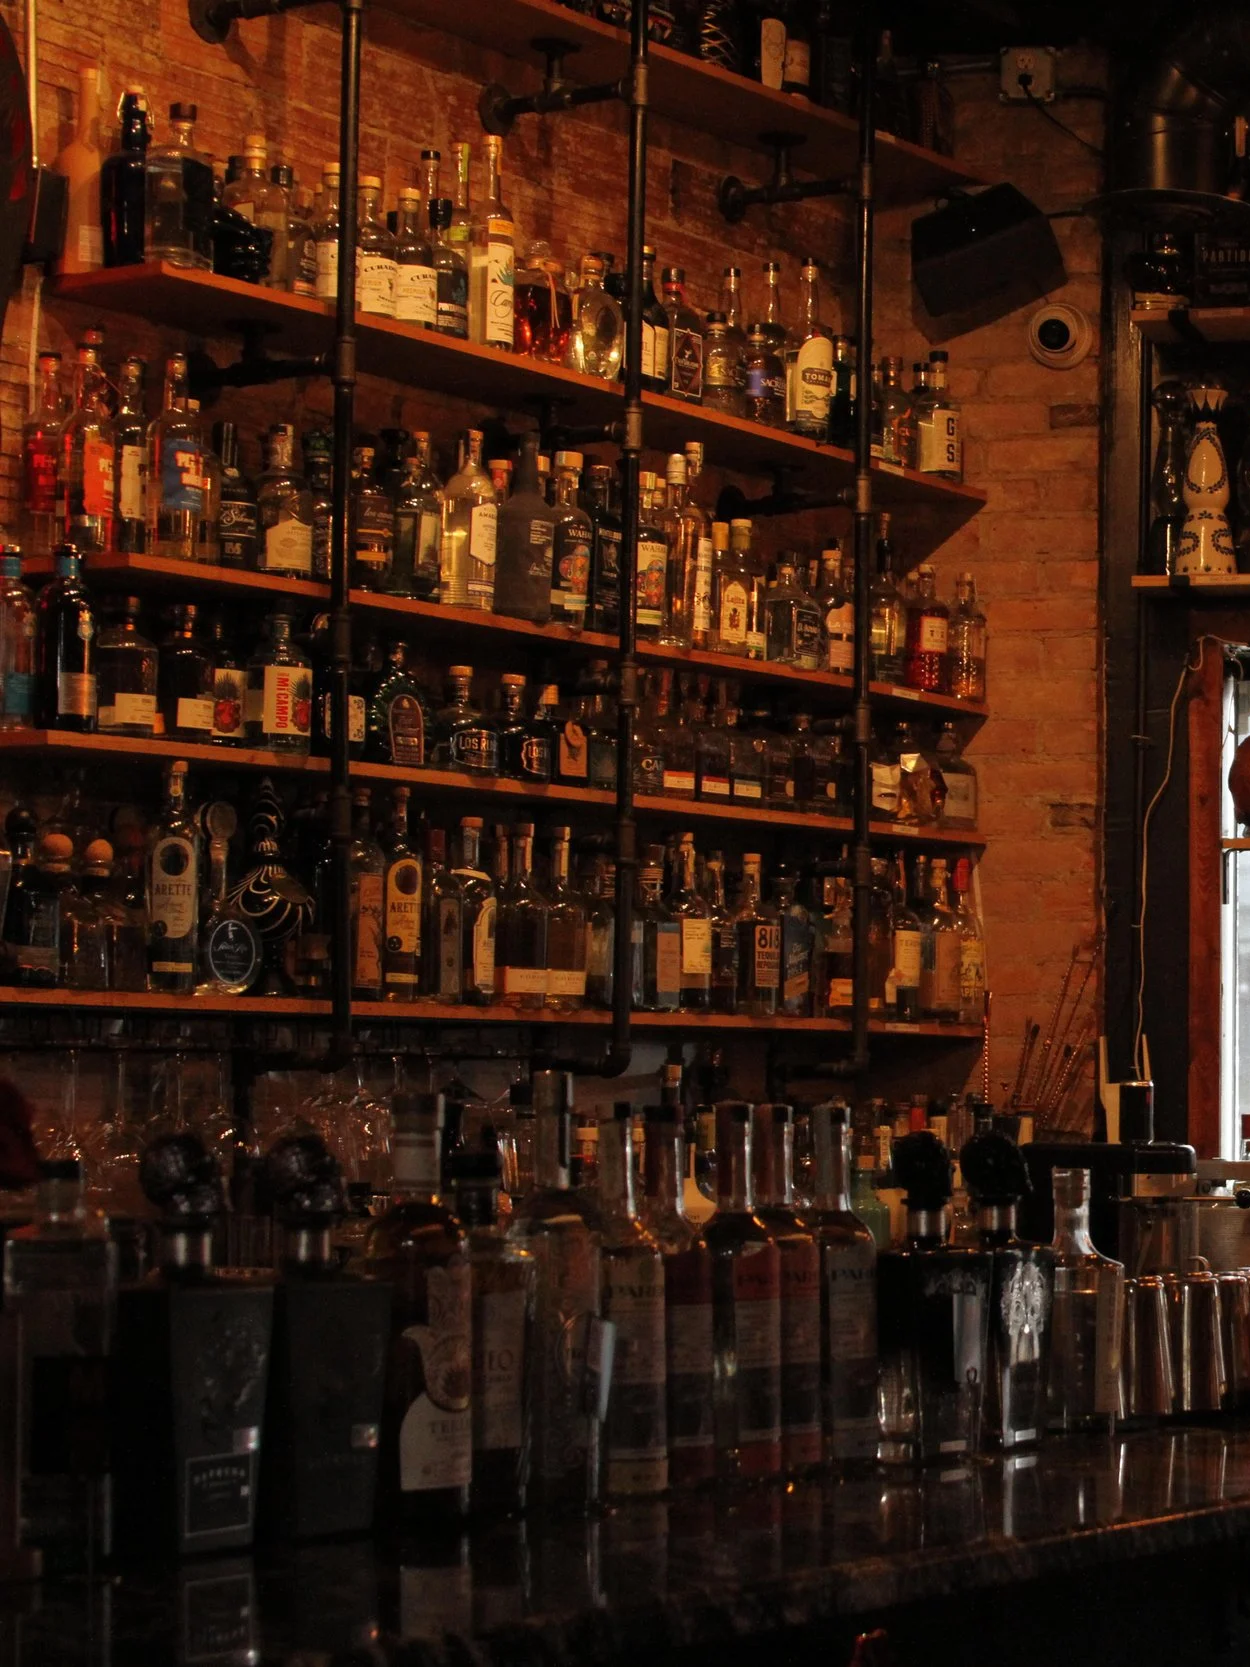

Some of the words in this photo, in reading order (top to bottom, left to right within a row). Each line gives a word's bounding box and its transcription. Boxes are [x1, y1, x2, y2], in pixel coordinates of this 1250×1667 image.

[276, 677, 289, 690] Mi
[275, 690, 289, 729] CAMPO
[458, 735, 479, 750] LOS
[154, 883, 193, 896] ARETTE
